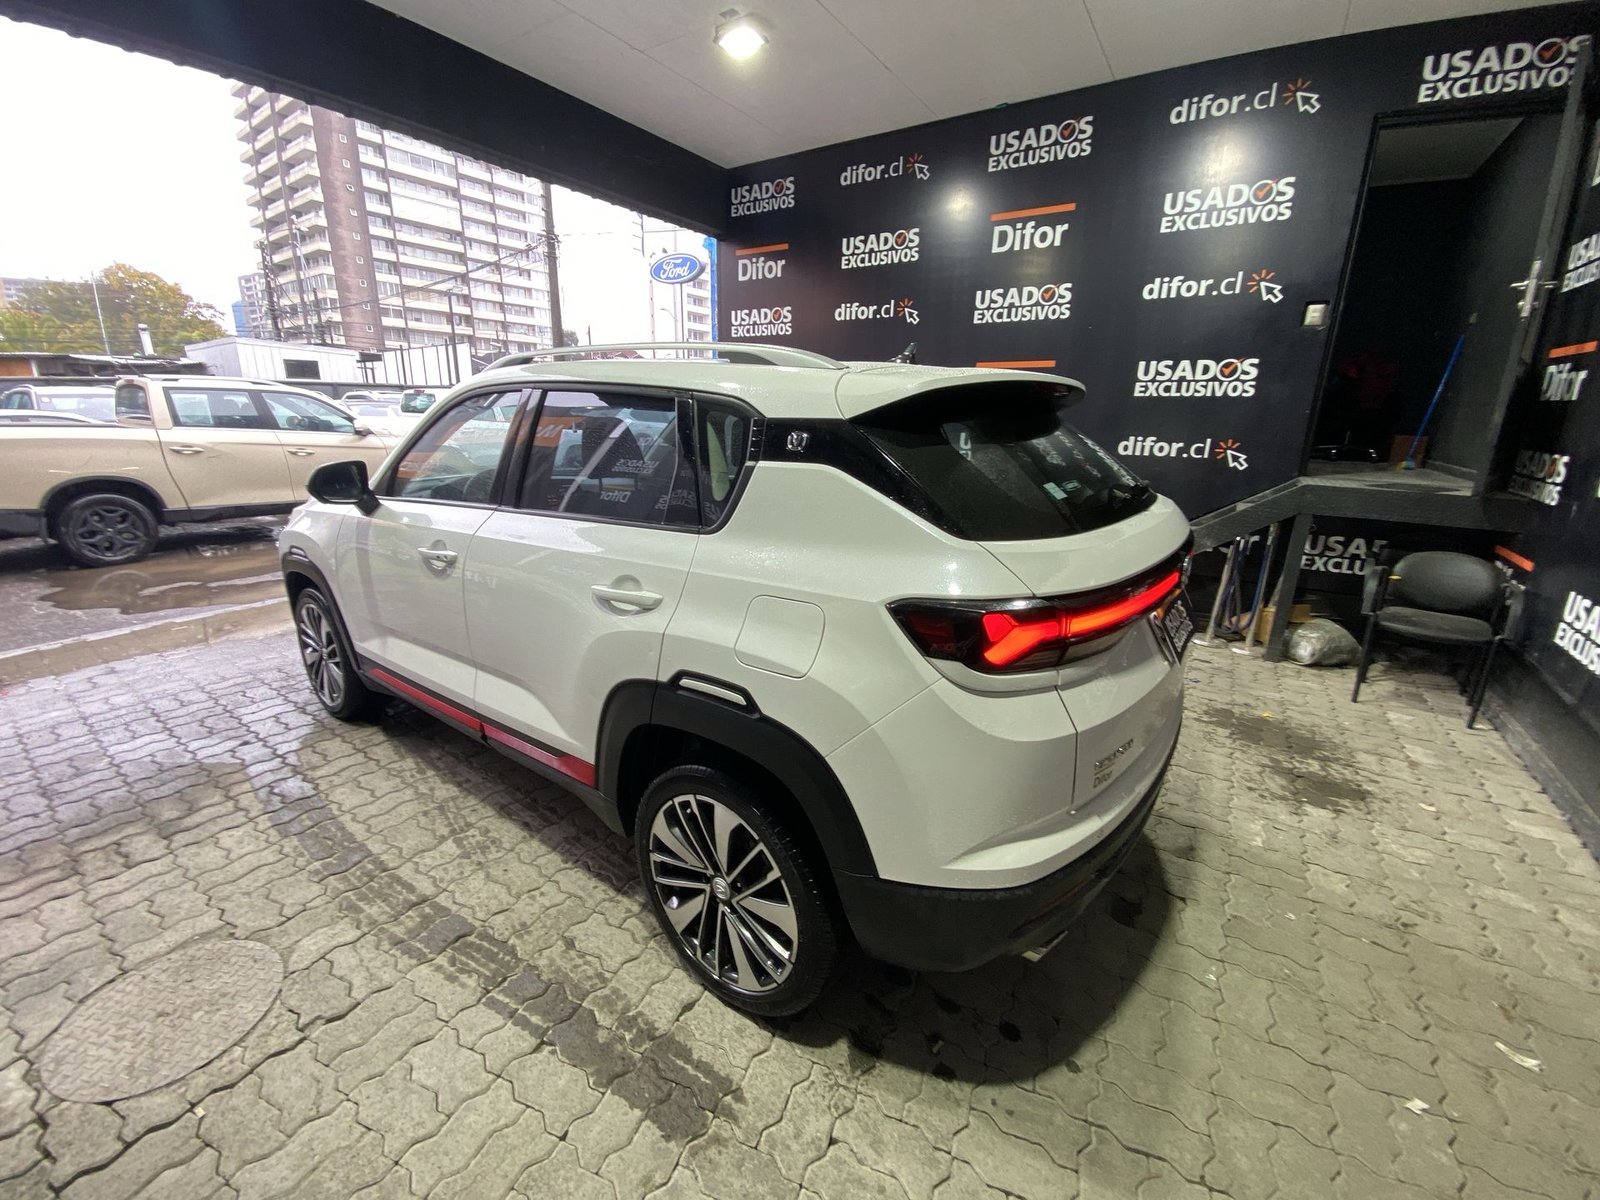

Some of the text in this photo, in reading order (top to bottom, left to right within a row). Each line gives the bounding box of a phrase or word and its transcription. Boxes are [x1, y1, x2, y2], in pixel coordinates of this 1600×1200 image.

[1169, 82, 1278, 125] difor.cl
[989, 116, 1094, 156] USADOS
[988, 139, 1092, 172] EXCLUSIVOS
[840, 156, 904, 186] difor.cl
[731, 176, 796, 204] USADOS
[1163, 176, 1296, 215] USADOS
[730, 194, 796, 217] EXCLUSIVOS
[1160, 201, 1293, 233] EXCLUSIVOS
[842, 227, 920, 255] USADOS
[991, 221, 1069, 254] Difor
[660, 258, 691, 280] Ford
[737, 256, 786, 282] Difor
[841, 246, 919, 270] EXCLUSIVOS
[975, 282, 1073, 309] USADOS
[1142, 271, 1244, 300] difor.cl
[731, 306, 792, 326] USADOS
[834, 299, 895, 322] difor.cl
[973, 302, 1071, 324] EXCLUSIVOS
[731, 321, 792, 338] EXCLUSIVOS
[1136, 358, 1260, 382] USADOS
[1134, 378, 1256, 397] EXCLUSIVOS
[1117, 436, 1212, 459] difor.cl
